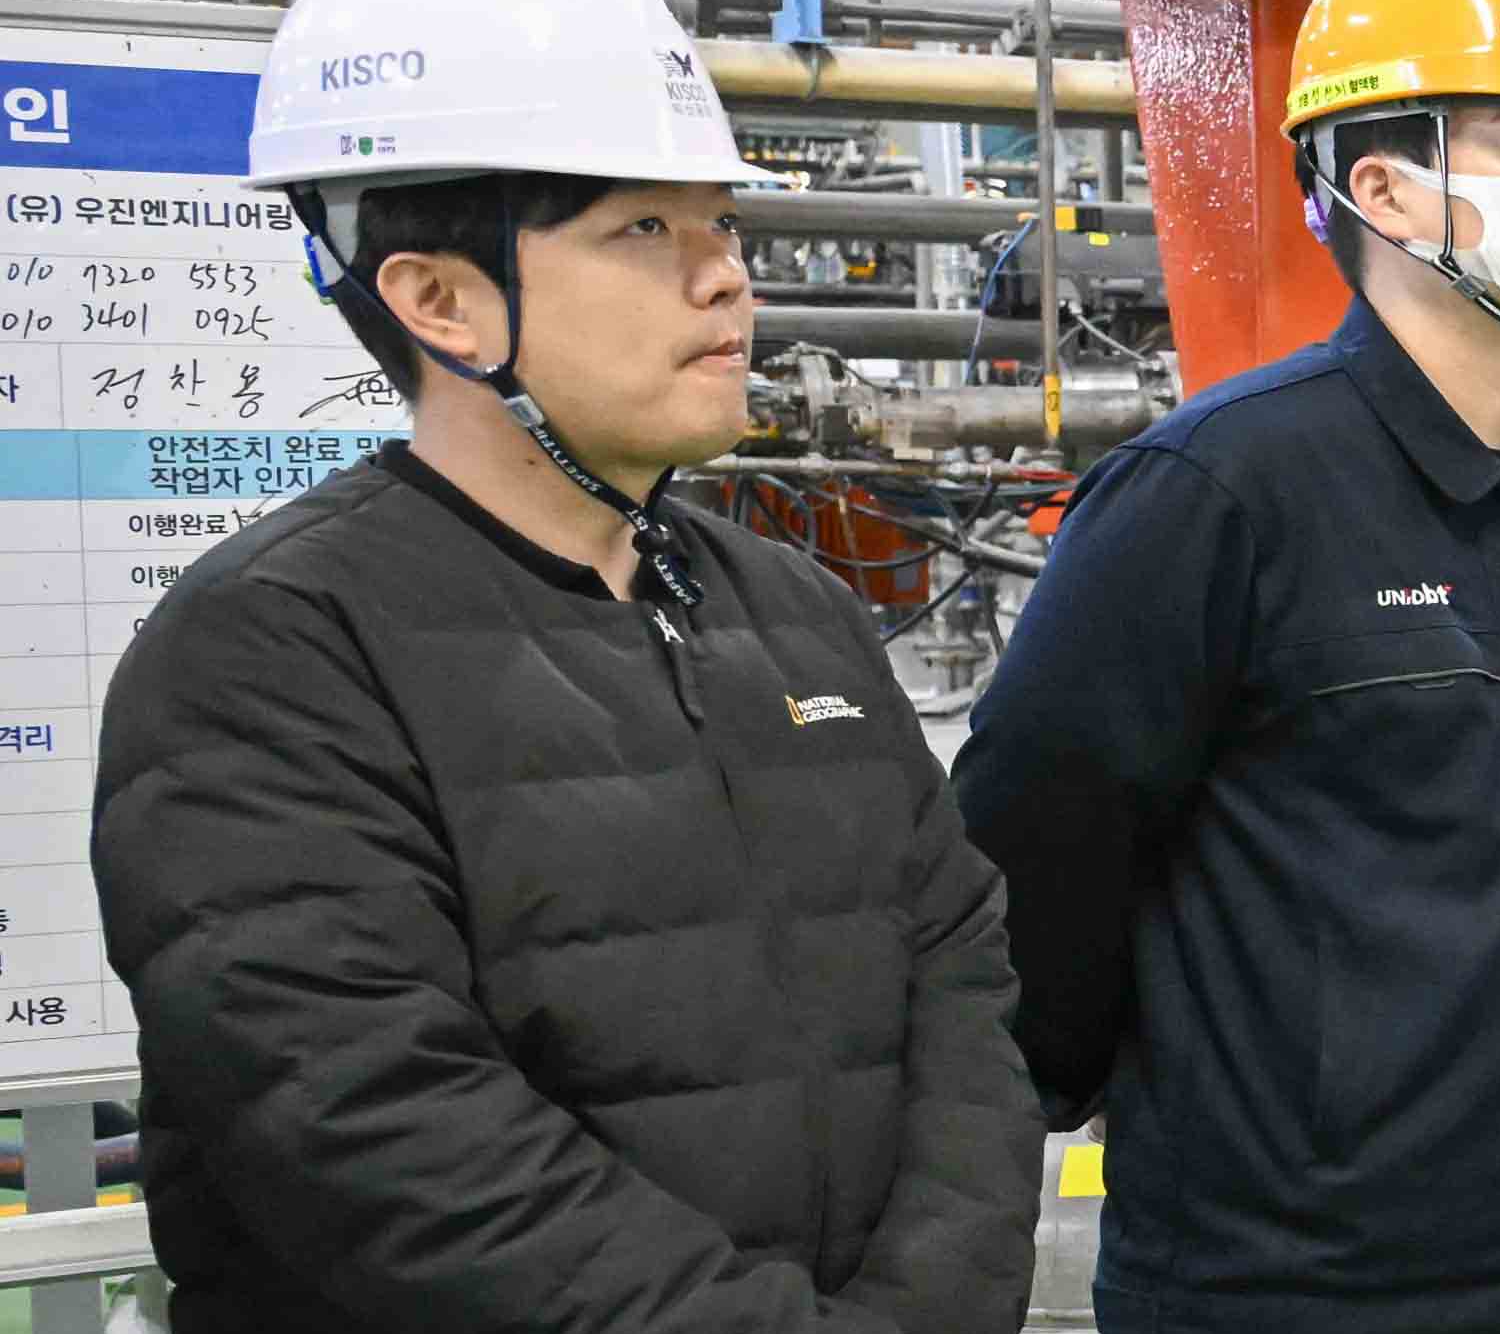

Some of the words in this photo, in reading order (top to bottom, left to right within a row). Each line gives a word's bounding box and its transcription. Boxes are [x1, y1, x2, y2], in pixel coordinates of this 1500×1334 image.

[321, 50, 425, 91] KISCO
[3, 87, 71, 144] 인
[7, 194, 62, 224] (유)
[75, 197, 293, 231] 우진엔지니어링
[81, 303, 148, 336] 3401
[147, 435, 272, 464] 안전조치
[285, 435, 345, 462] 완료
[149, 467, 243, 495] 작업자
[255, 467, 313, 493] 인지
[128, 513, 229, 538] 이행완료
[130, 565, 181, 589] 이행
[6, 997, 67, 1026] 사용
